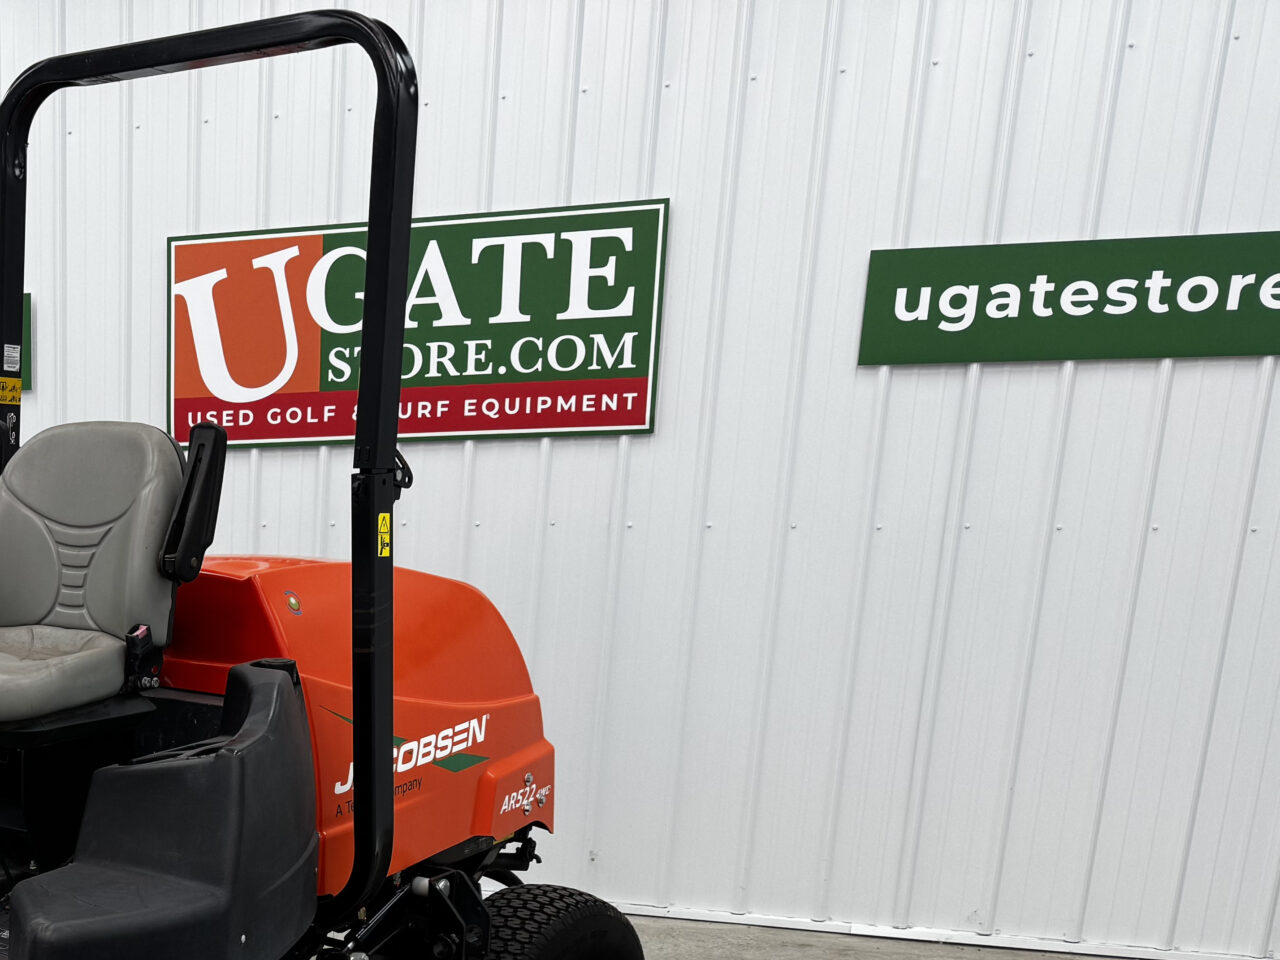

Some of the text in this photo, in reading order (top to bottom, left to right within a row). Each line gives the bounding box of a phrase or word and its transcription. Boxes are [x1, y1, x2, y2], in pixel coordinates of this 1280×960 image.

[894, 271, 1280, 332] ugatestore
[327, 332, 639, 383] SORE.COM
[188, 410, 254, 428] USED
[266, 406, 336, 425] GOLF
[398, 401, 450, 419] URF
[463, 393, 638, 419] EQUIPMENT
[334, 714, 487, 795] JOBSEN
[394, 777, 423, 797] mpany
[500, 783, 537, 815] AR522
